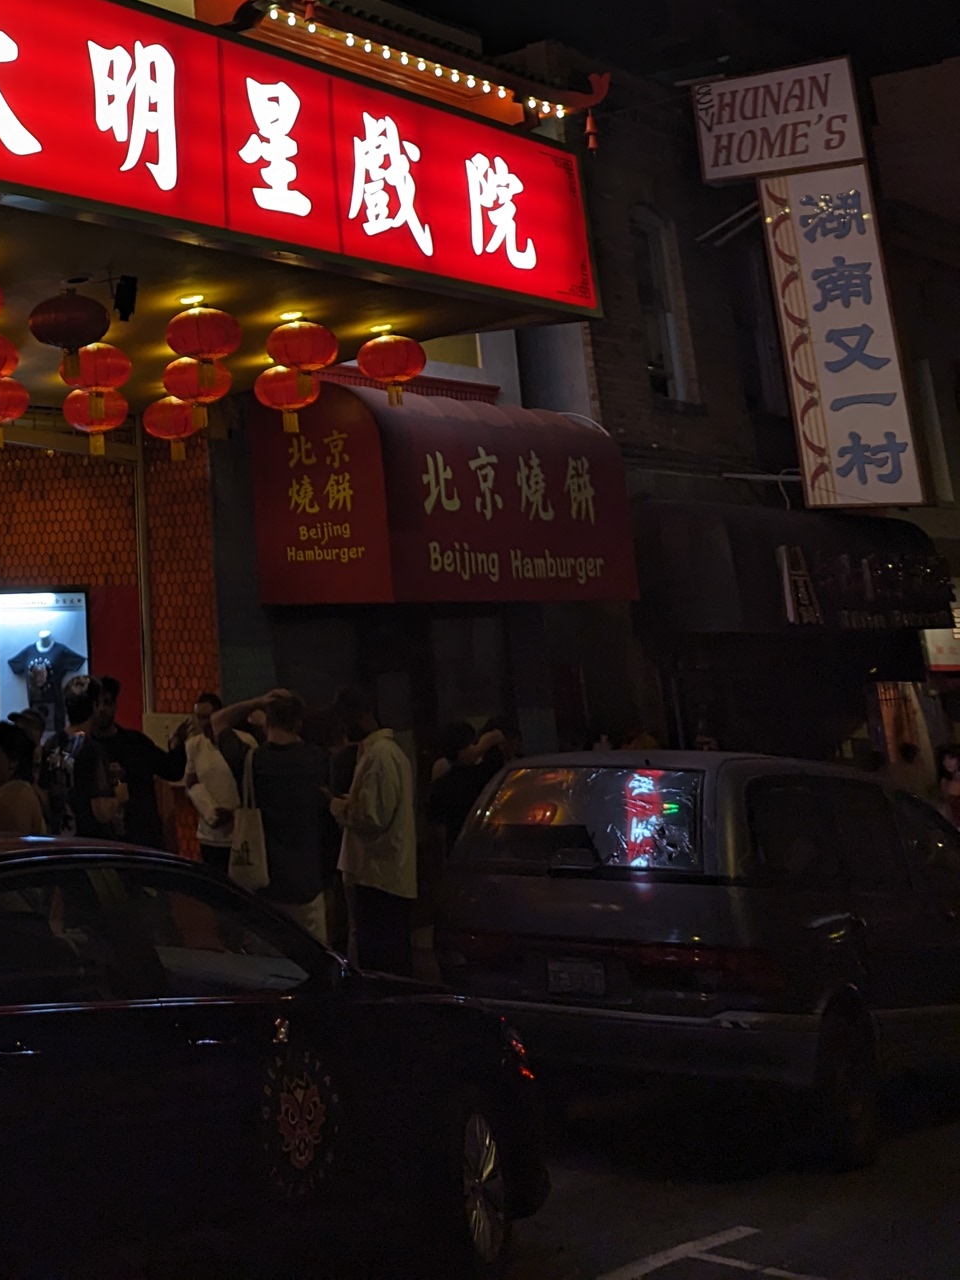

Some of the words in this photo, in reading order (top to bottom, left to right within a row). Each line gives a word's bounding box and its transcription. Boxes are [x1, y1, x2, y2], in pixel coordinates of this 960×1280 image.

[714, 73, 831, 125] HUNAN
[711, 114, 847, 167] HOME'S
[800, 188, 908, 485] 湖南又一村
[288, 429, 350, 469] 北京
[288, 472, 354, 514] 燒餅
[422, 446, 596, 525] 北京燒餅
[287, 545, 366, 563] Hamburger
[299, 522, 351, 545] Beijing
[428, 541, 500, 583] Beijing
[510, 549, 604, 586] Hamburger
